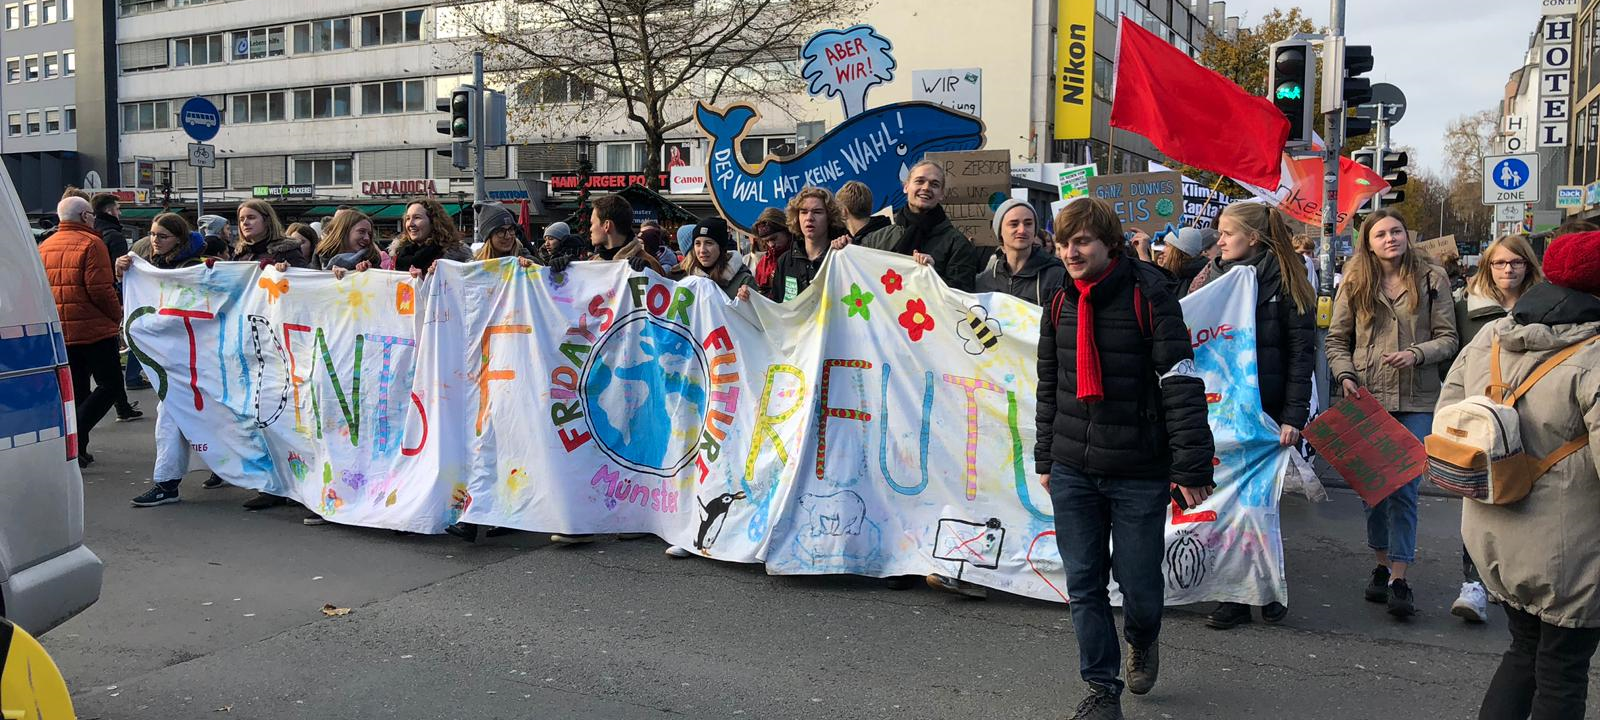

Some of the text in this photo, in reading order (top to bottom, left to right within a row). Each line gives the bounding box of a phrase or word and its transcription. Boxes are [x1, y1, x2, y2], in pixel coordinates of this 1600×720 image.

[825, 37, 867, 66] ABER
[1063, 24, 1086, 106] Nikon
[836, 57, 873, 85] WIR!
[922, 76, 959, 94] WIR
[1544, 21, 1571, 144] HOTEL
[362, 180, 437, 194] CAPPADOCIA
[552, 175, 626, 188] HAMURGER
[674, 175, 703, 184] Canon
[714, 148, 734, 190] DER
[733, 176, 768, 203] WAL
[774, 175, 800, 199] HAT
[804, 160, 844, 188] KEINE
[1497, 191, 1525, 200] ZONE
[1191, 324, 1234, 348] LOVE
[551, 295, 614, 453] FRIDAYS
[628, 276, 695, 326] FOR
[124, 305, 429, 456] STUDENTS
[590, 464, 680, 514] Münster
